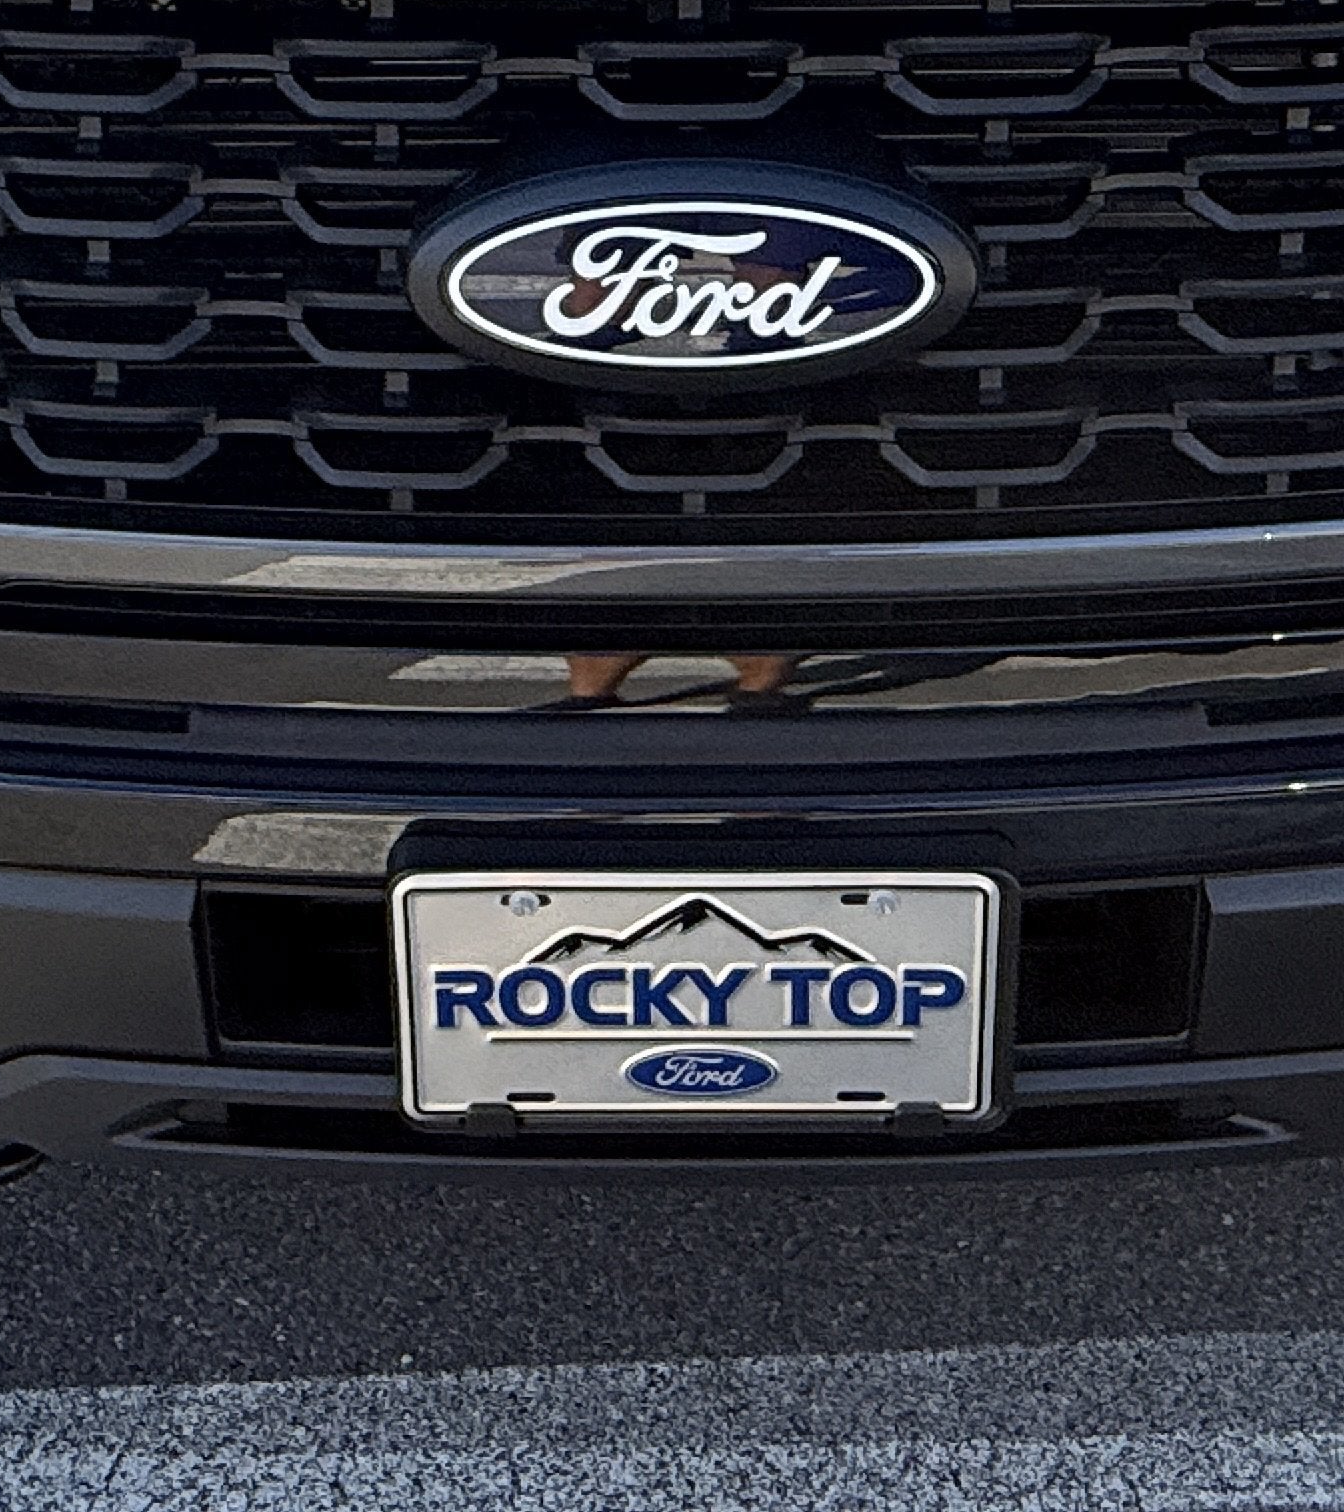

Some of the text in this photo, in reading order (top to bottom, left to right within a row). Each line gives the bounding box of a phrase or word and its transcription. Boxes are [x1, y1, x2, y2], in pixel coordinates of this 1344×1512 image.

[542, 225, 843, 338] Ford
[432, 966, 966, 1028] ROCKY TOP
[655, 1055, 744, 1090] Ford
